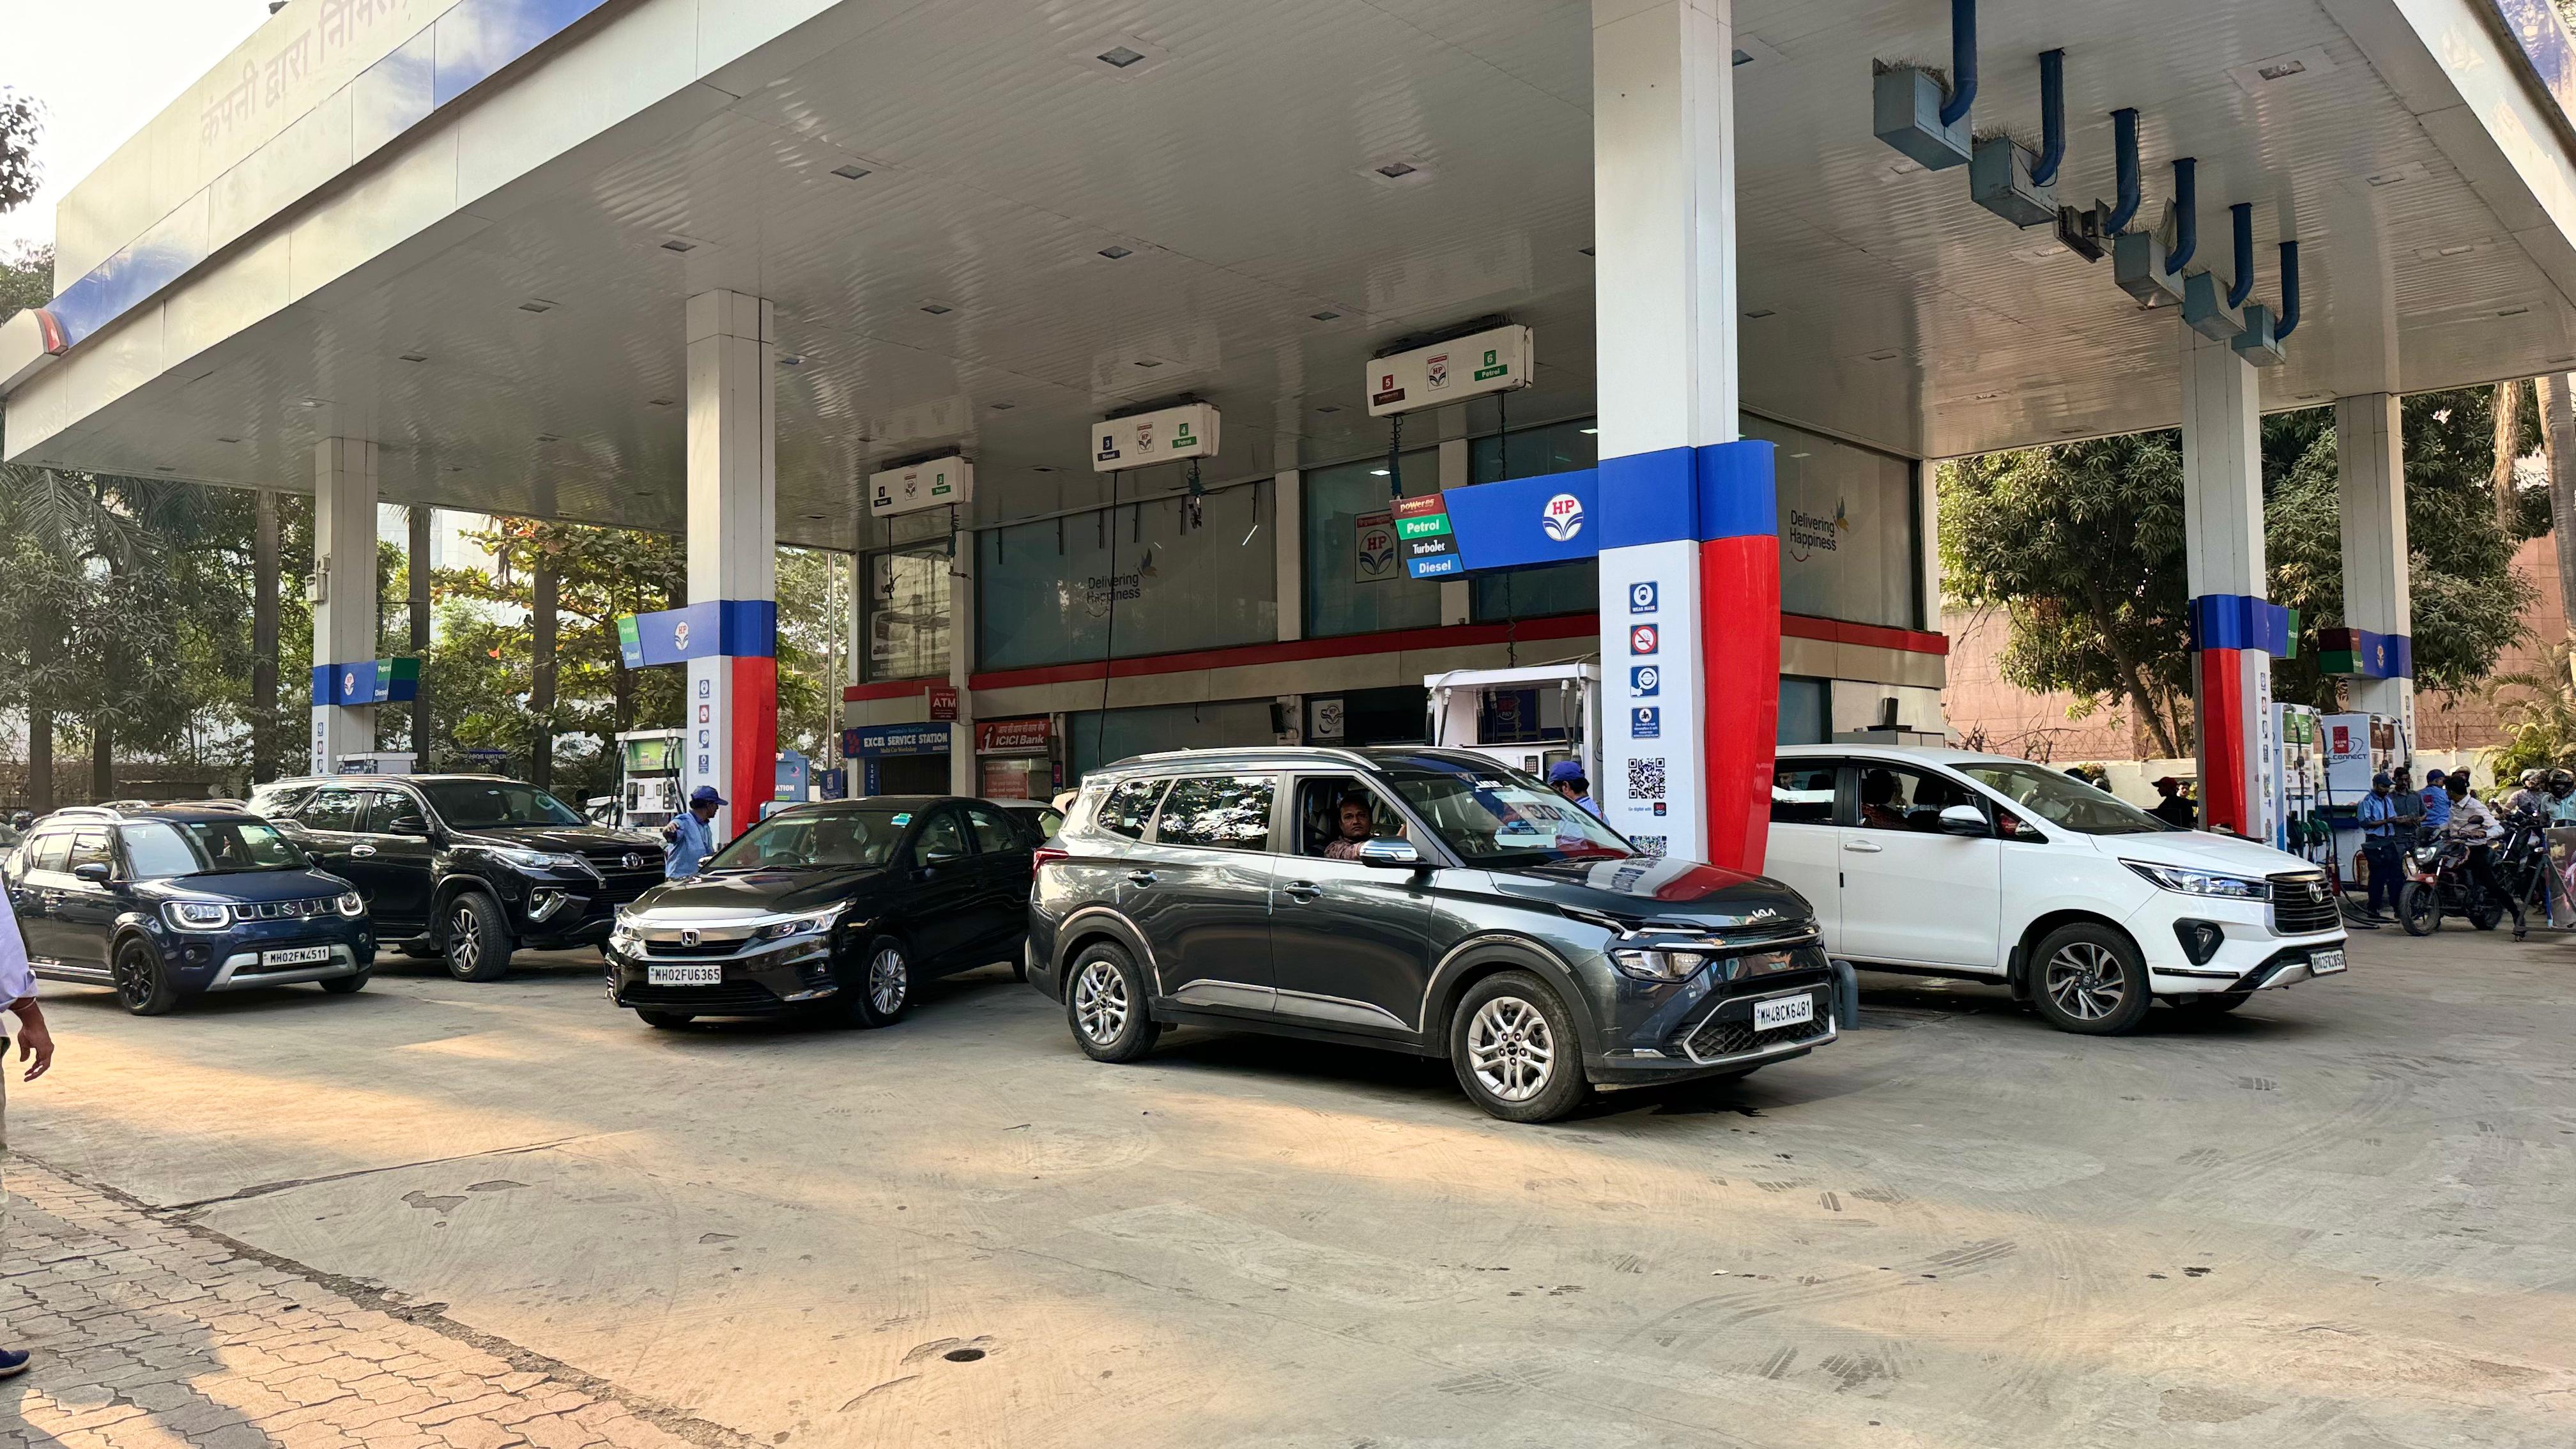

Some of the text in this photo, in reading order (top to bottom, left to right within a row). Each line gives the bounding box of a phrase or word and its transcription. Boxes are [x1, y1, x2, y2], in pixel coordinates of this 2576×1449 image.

[1487, 354, 1493, 364] 6
[1482, 368, 1500, 378] Petrol
[1385, 378, 1391, 387] 5
[1181, 426, 1186, 434] 4
[939, 475, 942, 484] 2
[1552, 500, 1575, 516] HP
[1406, 519, 1439, 534] Petrol
[1791, 509, 1835, 537] Delivering
[1367, 535, 1387, 551] HP
[1790, 526, 1836, 551] Happiness
[1419, 560, 1451, 574] Diesel
[1088, 573, 1139, 590] Delivering
[1087, 588, 1140, 606] Happiness
[678, 625, 687, 634] HP
[378, 664, 391, 673] Petrol
[374, 688, 388, 696] Diesel
[932, 698, 956, 708] ATM
[864, 733, 947, 747] EXCEL SERVICE STATION
[995, 734, 1044, 746] ICICI Bank
[270, 949, 326, 963] MH02FN4511
[655, 968, 720, 981] MH02FU6365
[1761, 1000, 1810, 1025] MH48CK6481
